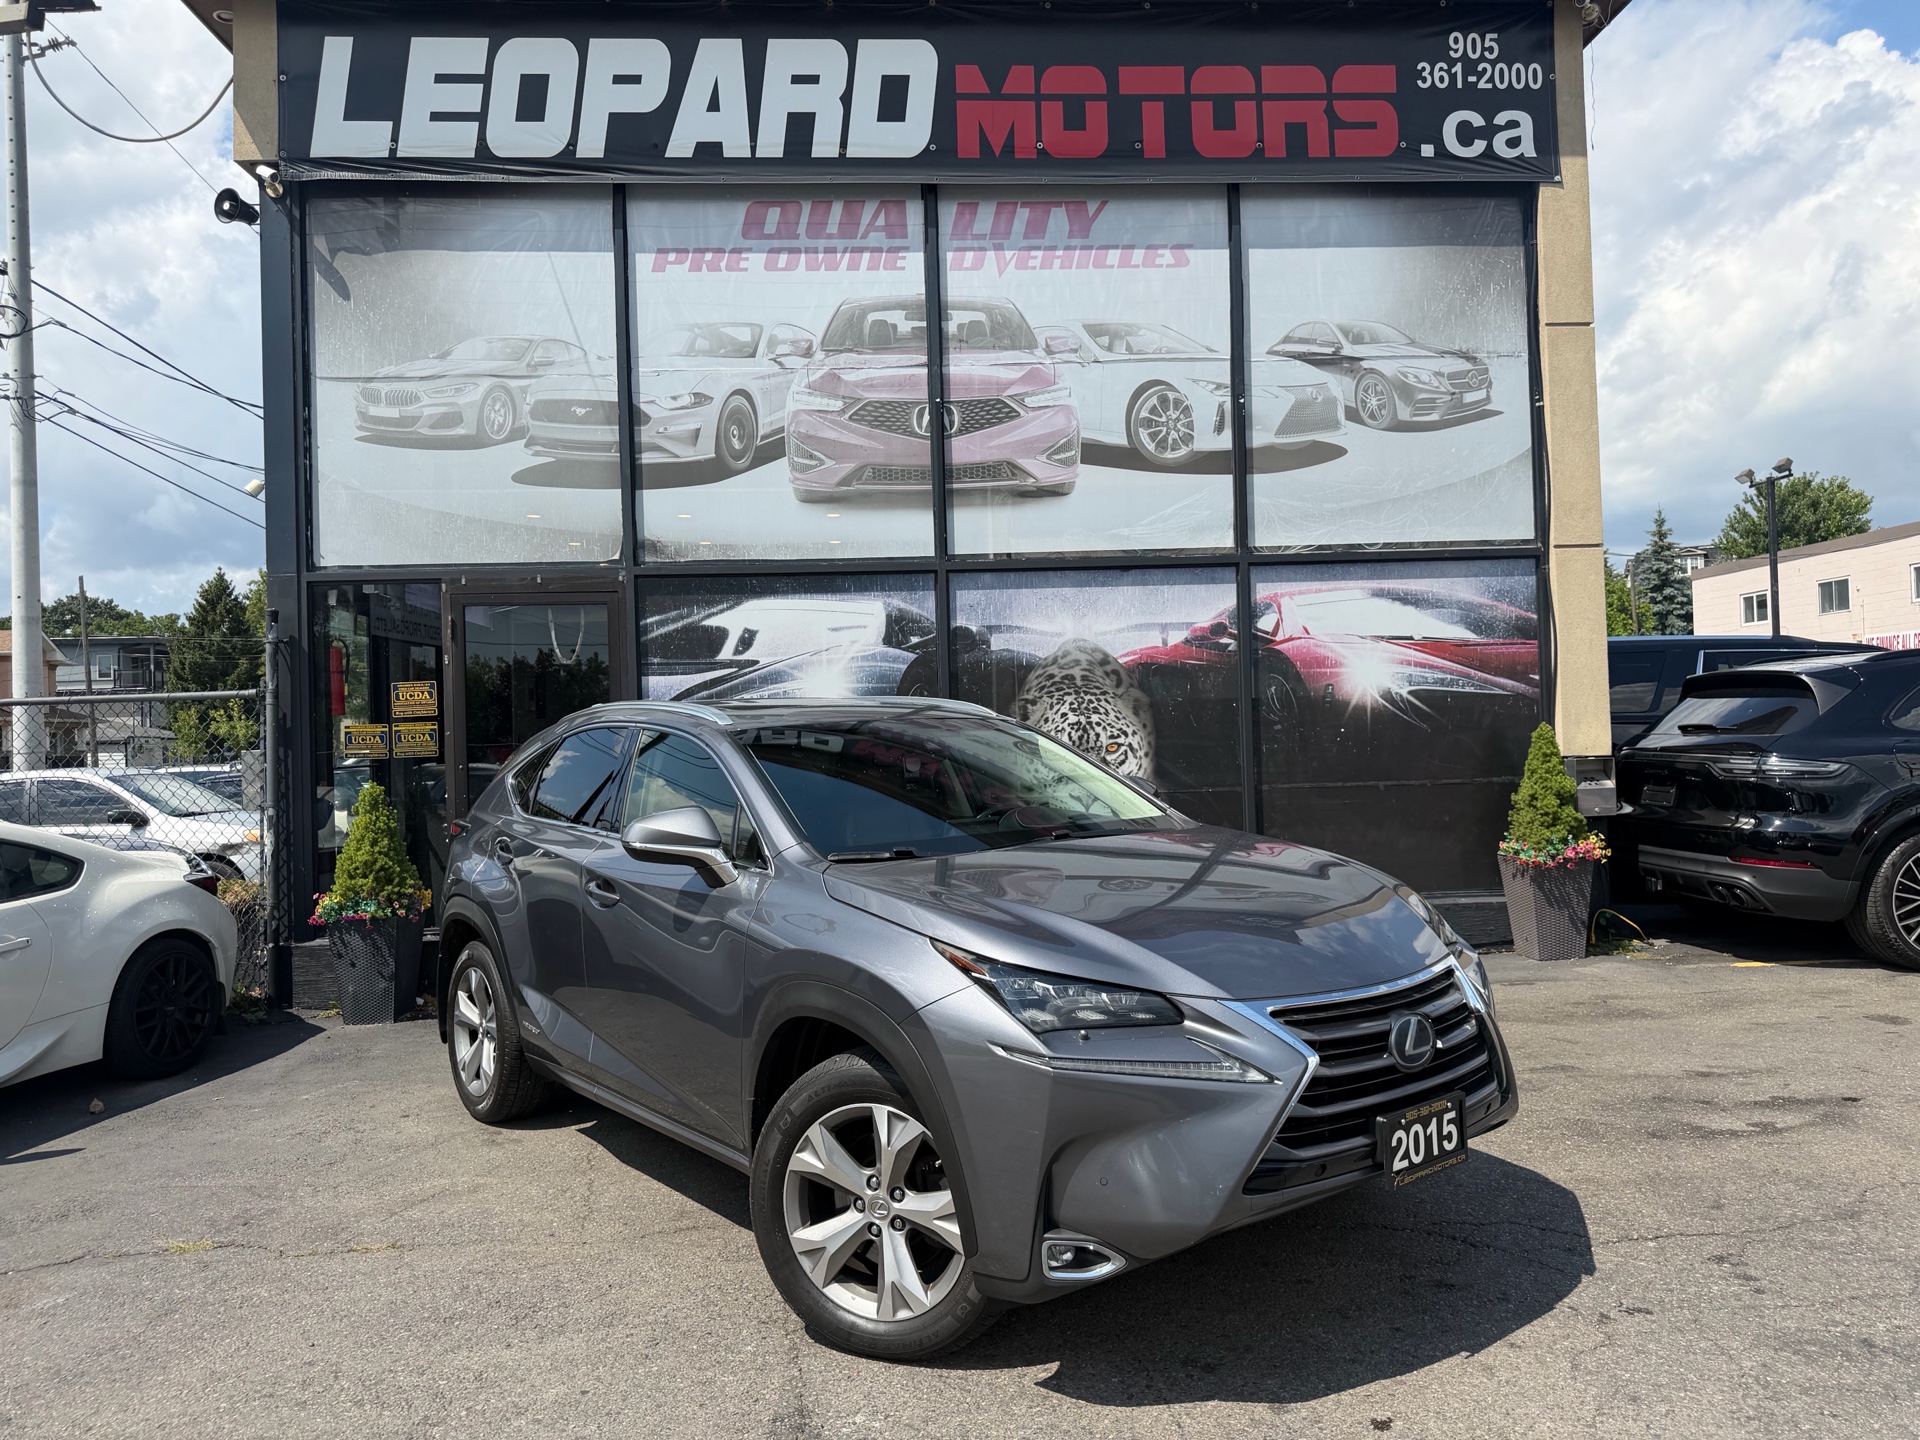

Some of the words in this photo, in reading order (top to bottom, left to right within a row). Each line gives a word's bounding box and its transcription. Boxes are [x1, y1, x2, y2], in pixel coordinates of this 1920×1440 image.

[1448, 32, 1500, 60] 905
[1416, 61, 1543, 91] 361-2000
[310, 36, 939, 158] LEOPARD
[955, 64, 1399, 159] MOTORS
[1421, 109, 1537, 158] .ca
[651, 247, 753, 273] PRE
[398, 691, 431, 701] UCDA
[351, 735, 382, 744] UCDA
[400, 733, 432, 742] UCDA
[1405, 1100, 1447, 1121] 905-361-2000
[1391, 1110, 1458, 1172] 2015
